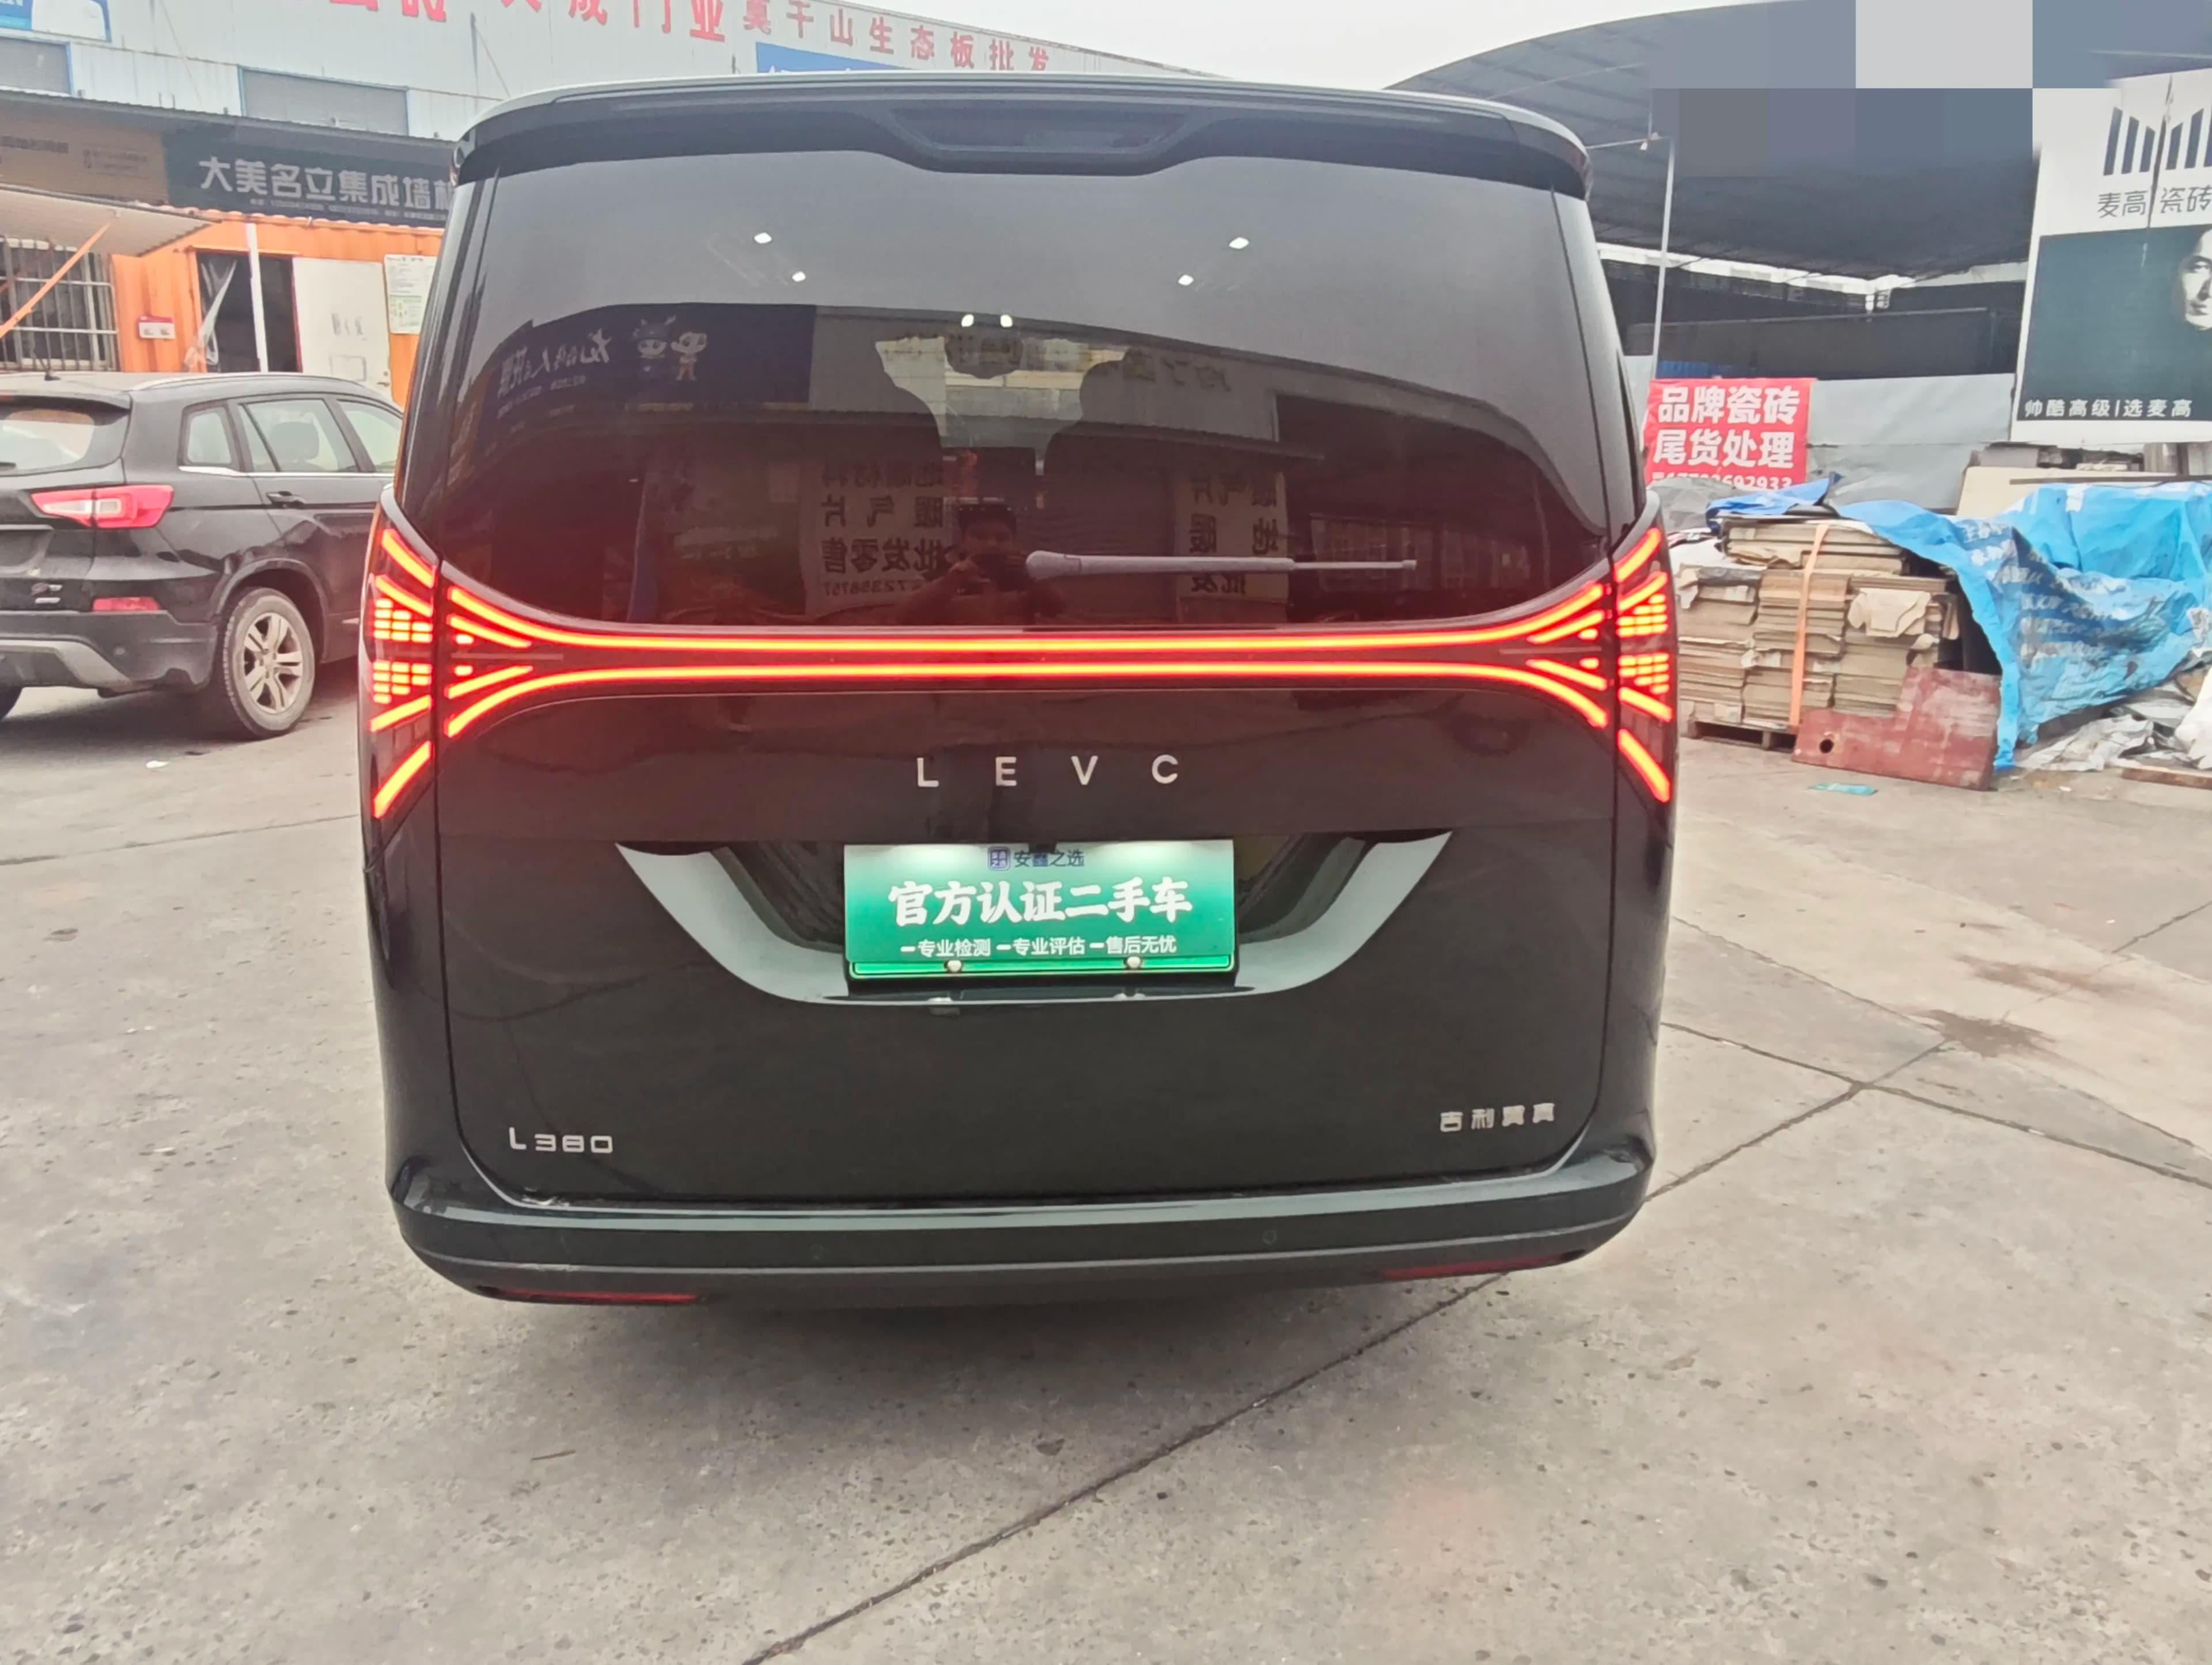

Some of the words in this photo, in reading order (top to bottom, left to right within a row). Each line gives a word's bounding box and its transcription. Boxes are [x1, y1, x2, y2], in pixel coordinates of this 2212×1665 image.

[2097, 191, 2149, 219] 麦高
[2160, 185, 2212, 214] 瓷砖
[1658, 385, 1801, 424] 品牌瓷砖
[1653, 428, 1795, 469] 尾货处理
[917, 754, 1179, 788] LEVC
[889, 876, 1194, 927] 官方认证二手车
[508, 1127, 613, 1154] L380
